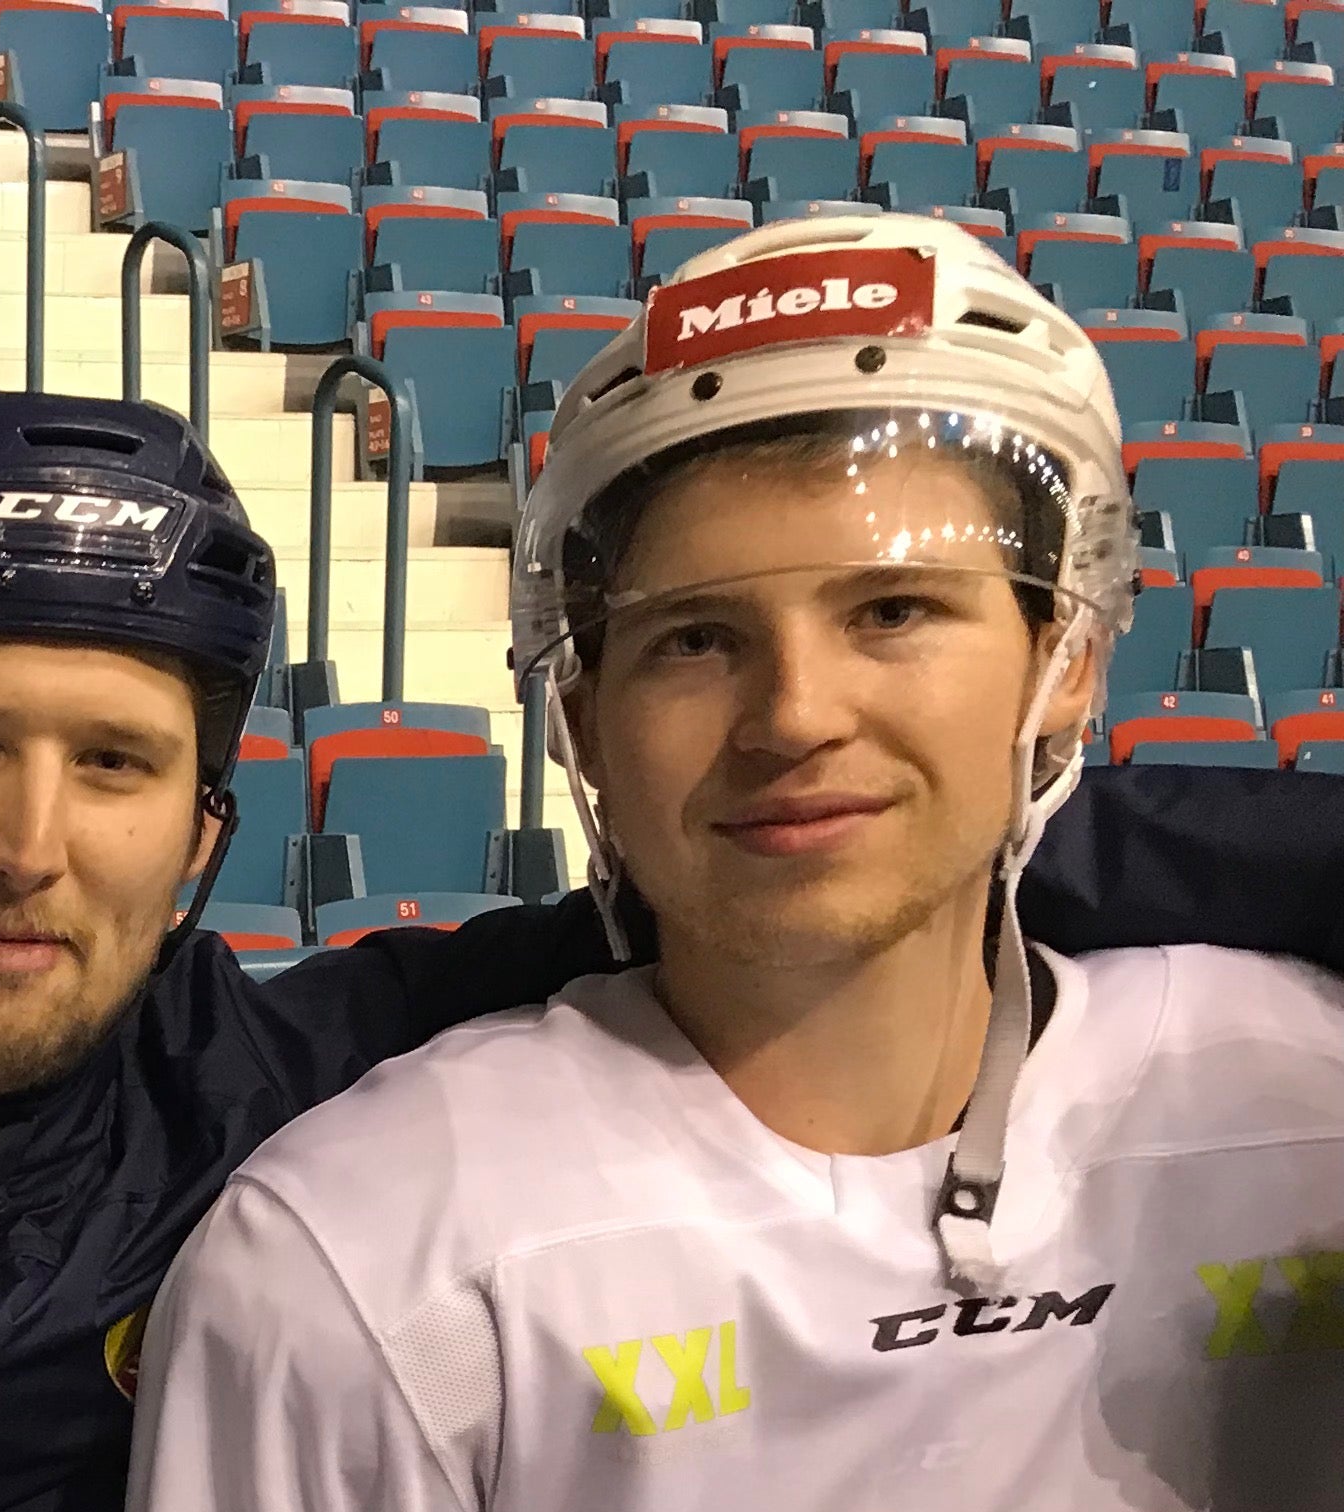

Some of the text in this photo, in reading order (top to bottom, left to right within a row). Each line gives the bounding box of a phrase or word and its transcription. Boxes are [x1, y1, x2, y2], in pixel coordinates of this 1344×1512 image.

[419, 294, 432, 304] 43
[677, 278, 898, 341] Miele
[1163, 696, 1175, 707] 42
[1322, 693, 1333, 703] 41
[384, 711, 398, 723] 50
[400, 903, 416, 916] 51
[870, 1283, 1117, 1354] CCM
[582, 1319, 751, 1437] XXL
